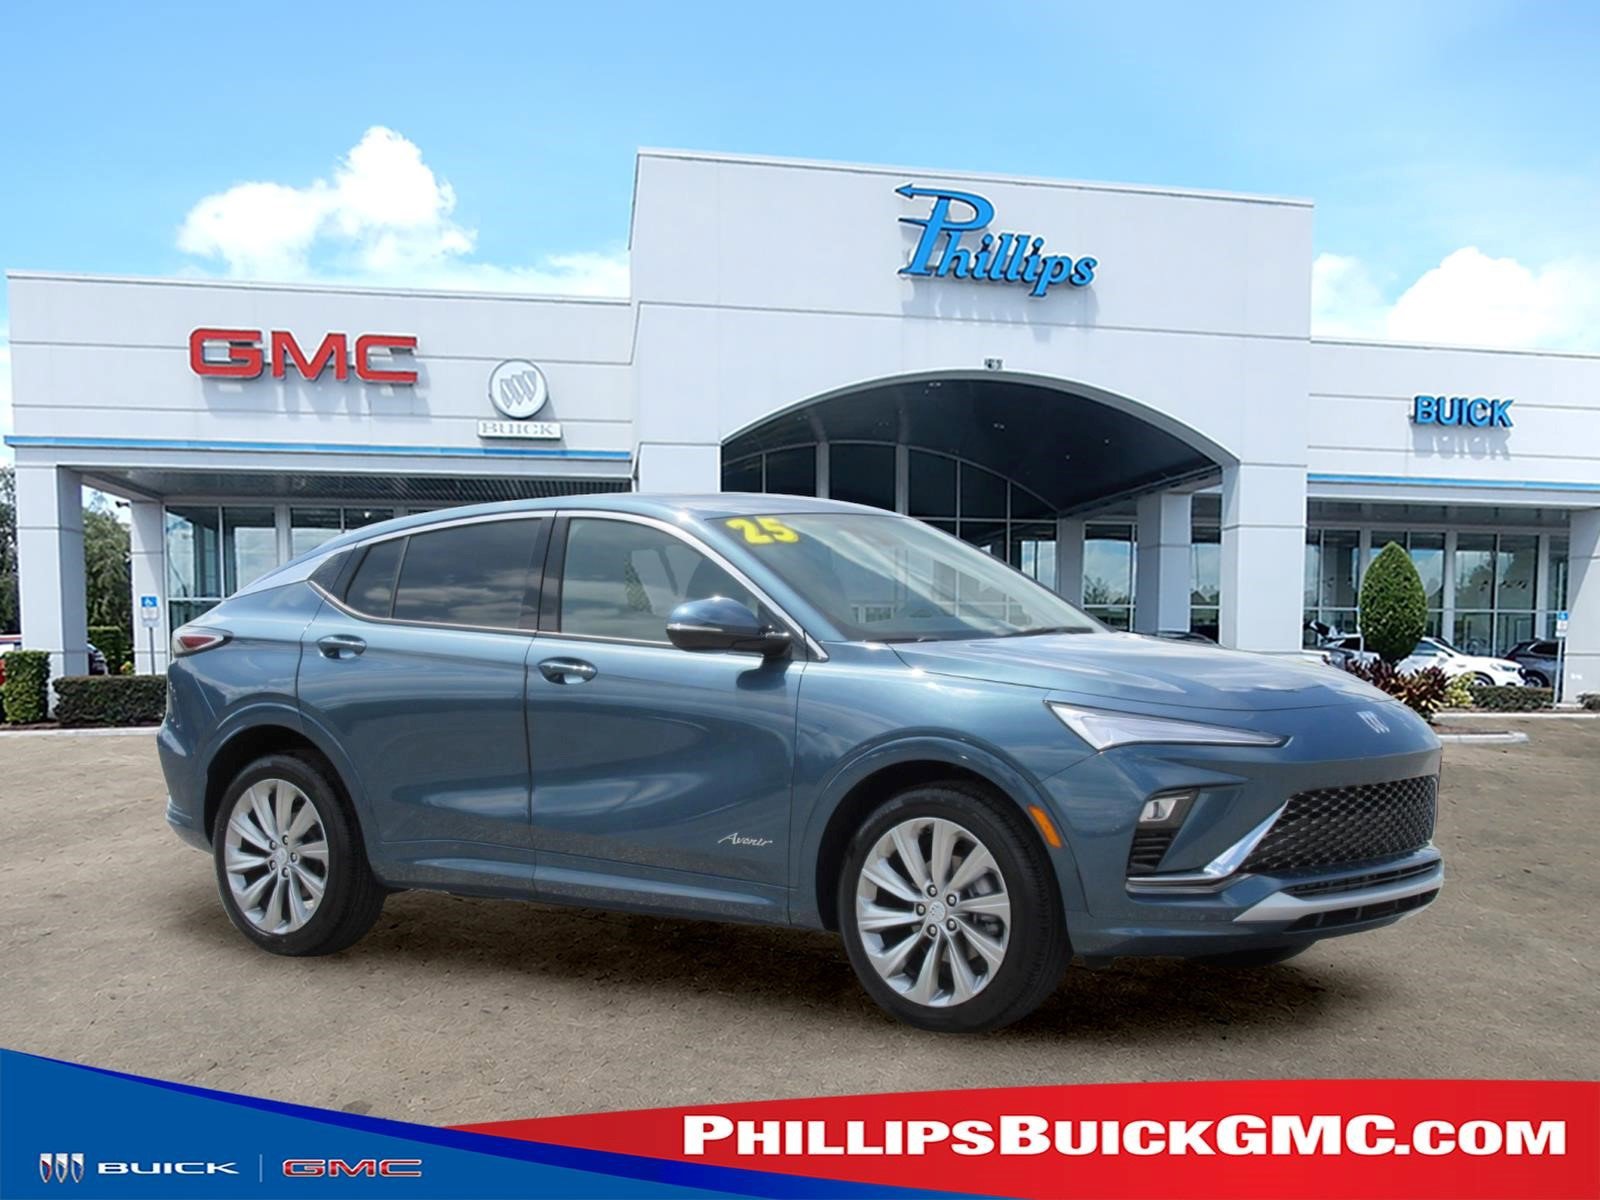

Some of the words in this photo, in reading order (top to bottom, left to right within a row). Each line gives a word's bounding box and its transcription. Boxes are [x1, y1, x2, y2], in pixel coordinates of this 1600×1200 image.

[894, 184, 1098, 298] Phillips
[189, 327, 418, 385] GMC
[1413, 395, 1514, 427] BUICK
[482, 422, 554, 435] BUICK
[725, 516, 799, 544] 25
[717, 832, 773, 846] Avenir
